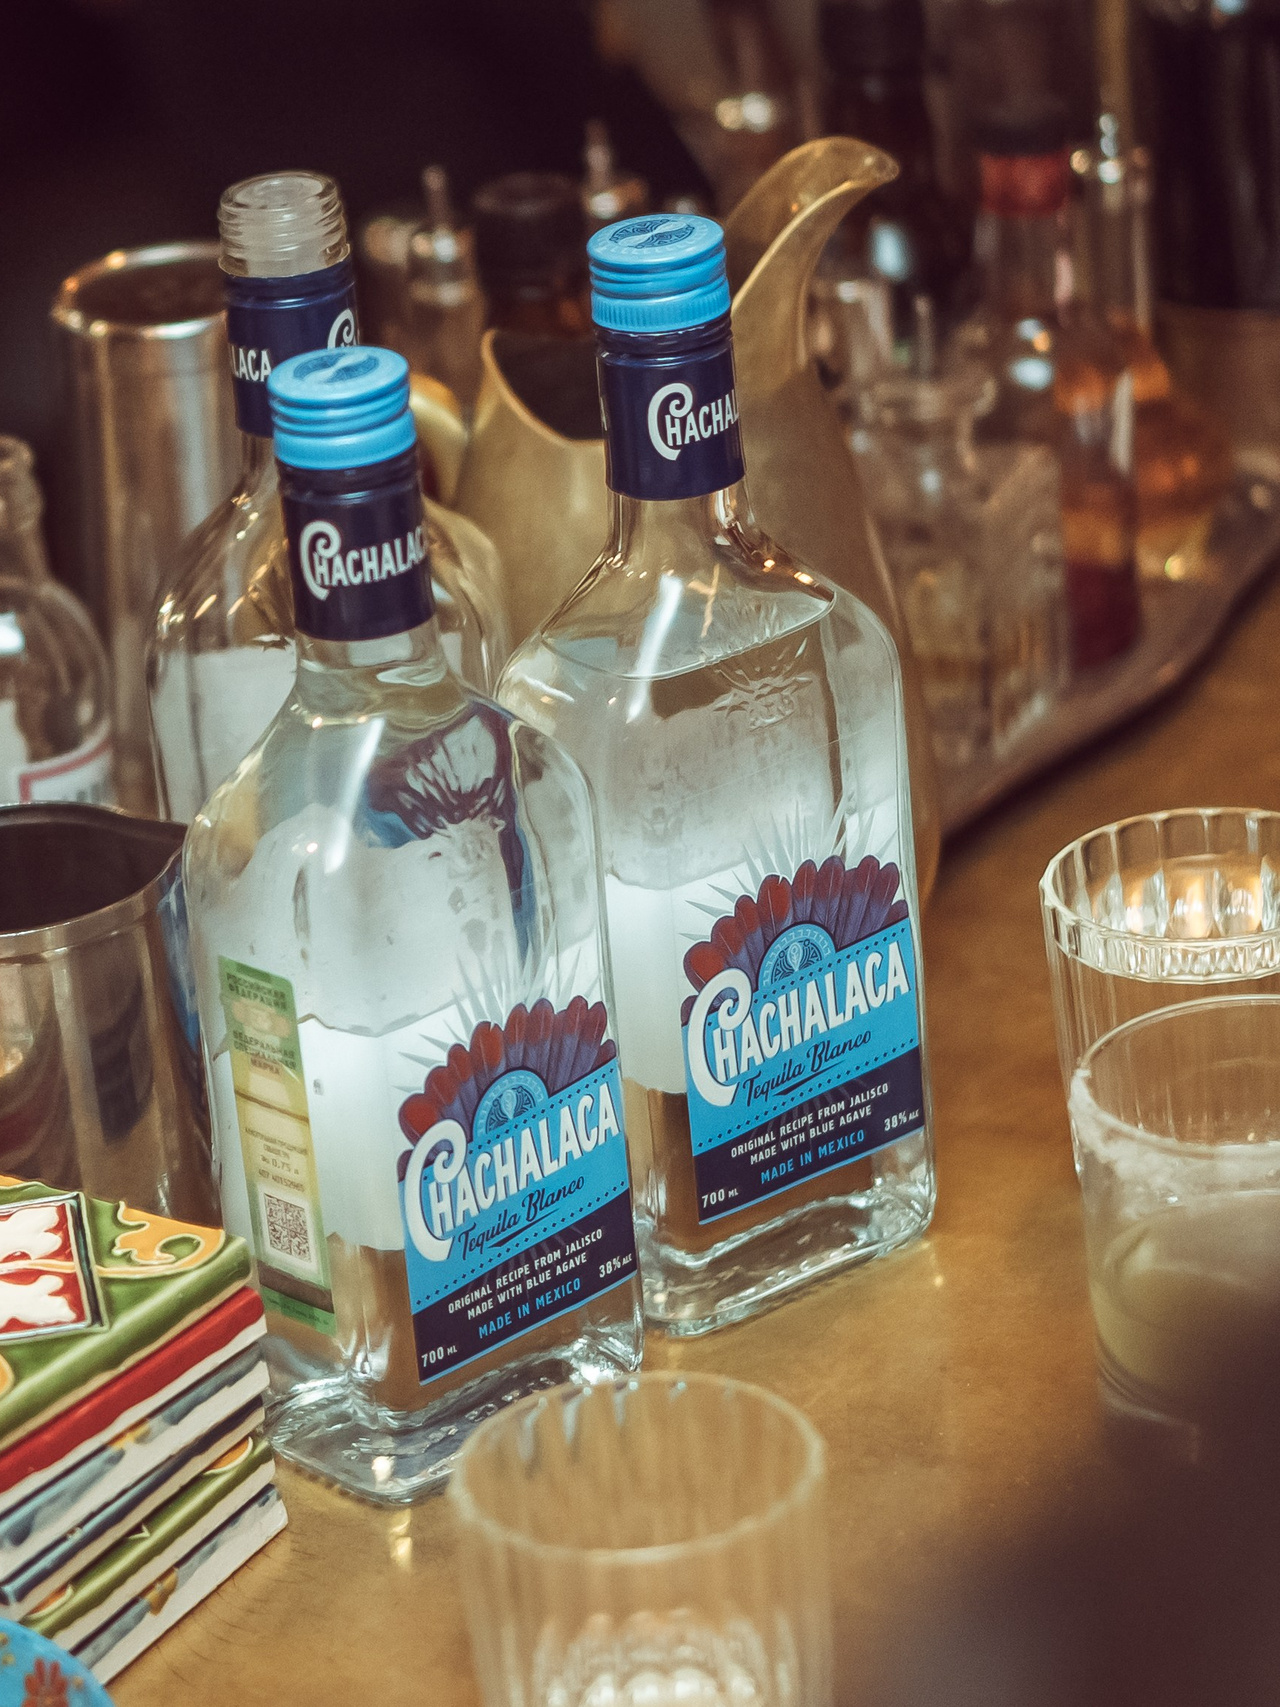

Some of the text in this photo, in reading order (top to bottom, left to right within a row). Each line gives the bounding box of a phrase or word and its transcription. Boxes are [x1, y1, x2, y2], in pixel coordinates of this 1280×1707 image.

[687, 941, 910, 1106] CHACHALACA
[742, 1030, 872, 1107] Tequila Blanco
[731, 1082, 889, 1158] ORIGINAL RECIPE FROM JALISCO
[750, 1104, 872, 1165] MADE WITH BLUE AGAVE
[884, 1111, 907, 1132] 38%
[272, 1158, 291, 1173] 0,75
[404, 1082, 620, 1261] CHACHALACA
[761, 1129, 865, 1184] MADE IN MEXICO
[458, 1176, 585, 1260] Tequila Blanco
[701, 1187, 739, 1208] 700 ML
[448, 1228, 603, 1314] ORIGINAL RECIPE FROM JALISCO
[467, 1252, 588, 1321] MADE WITH BLUE AGAVE
[598, 1255, 621, 1279] 38%
[478, 1277, 581, 1339] MADE IN MEXICO
[421, 1344, 458, 1368] 700 ML
